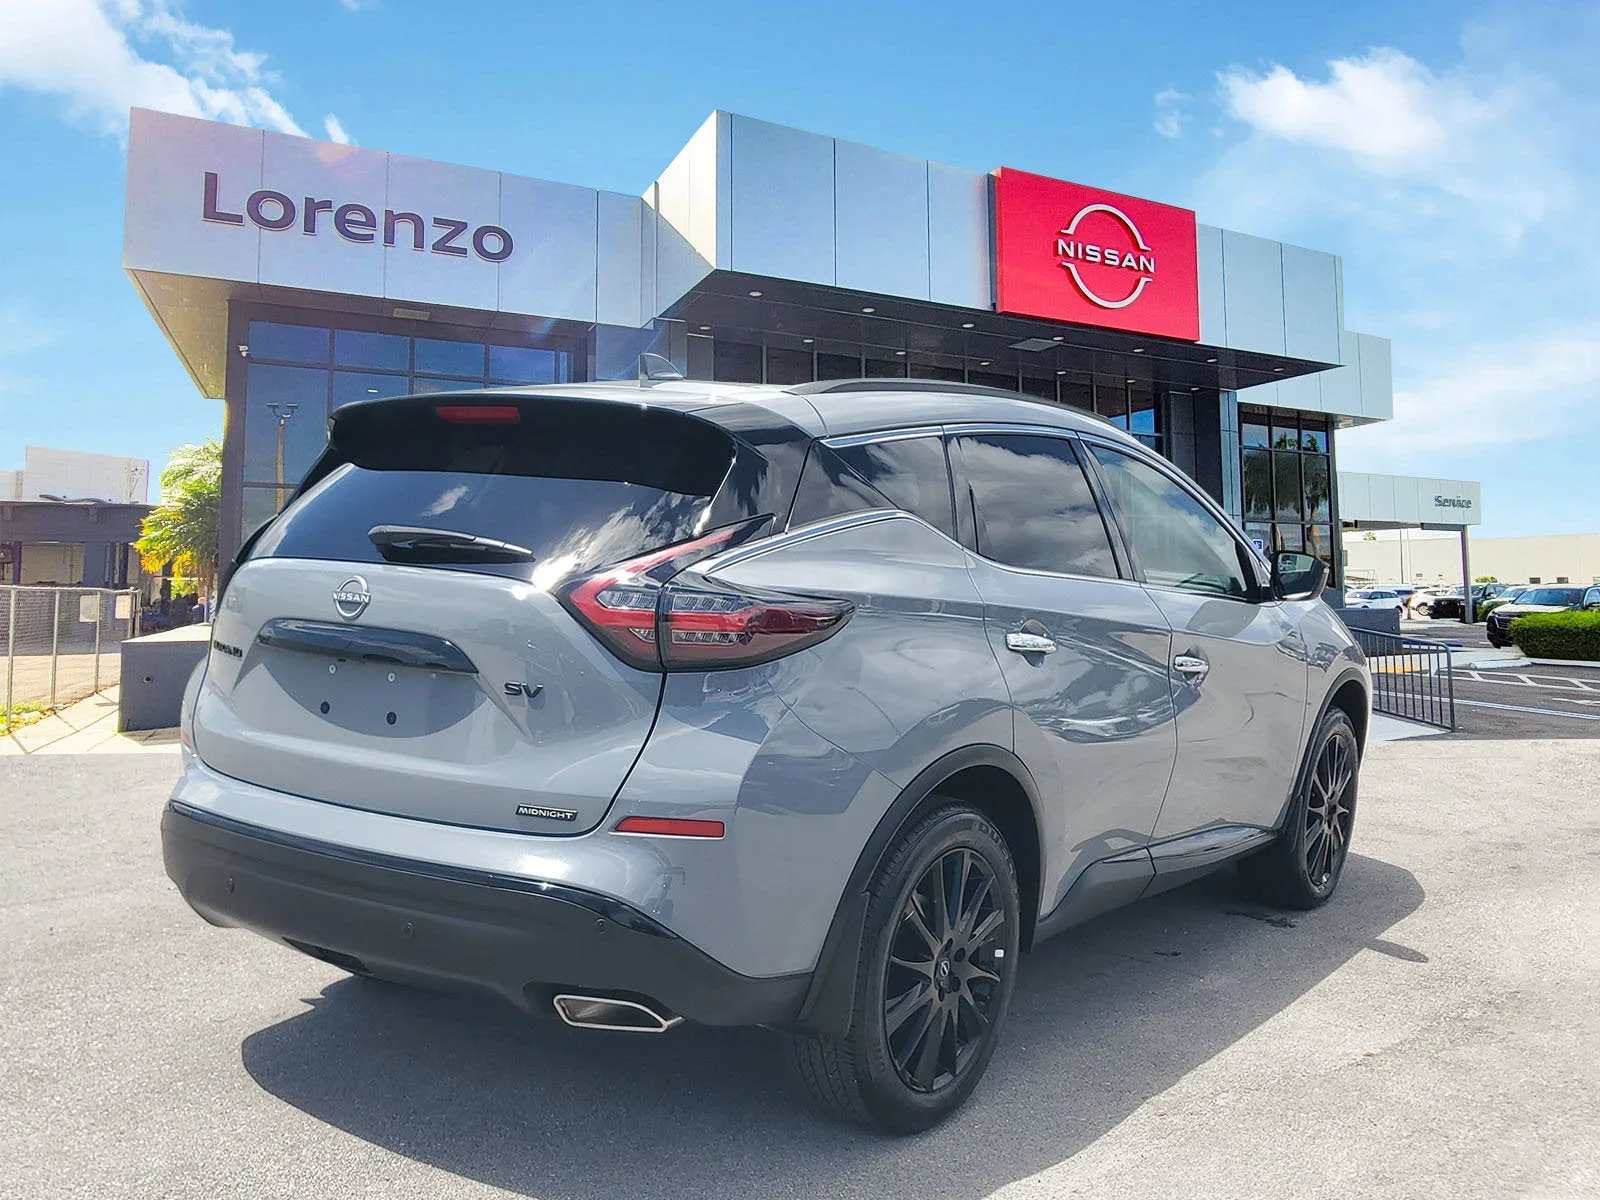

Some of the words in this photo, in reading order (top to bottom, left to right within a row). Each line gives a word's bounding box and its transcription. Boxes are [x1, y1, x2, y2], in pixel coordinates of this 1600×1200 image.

[202, 171, 515, 263] Lorenzo
[1057, 238, 1155, 273] NISSAN
[1434, 495, 1472, 509] Service
[333, 592, 369, 603] NISSAN
[504, 681, 544, 699] SV
[518, 807, 574, 820] MIDNIGHT
